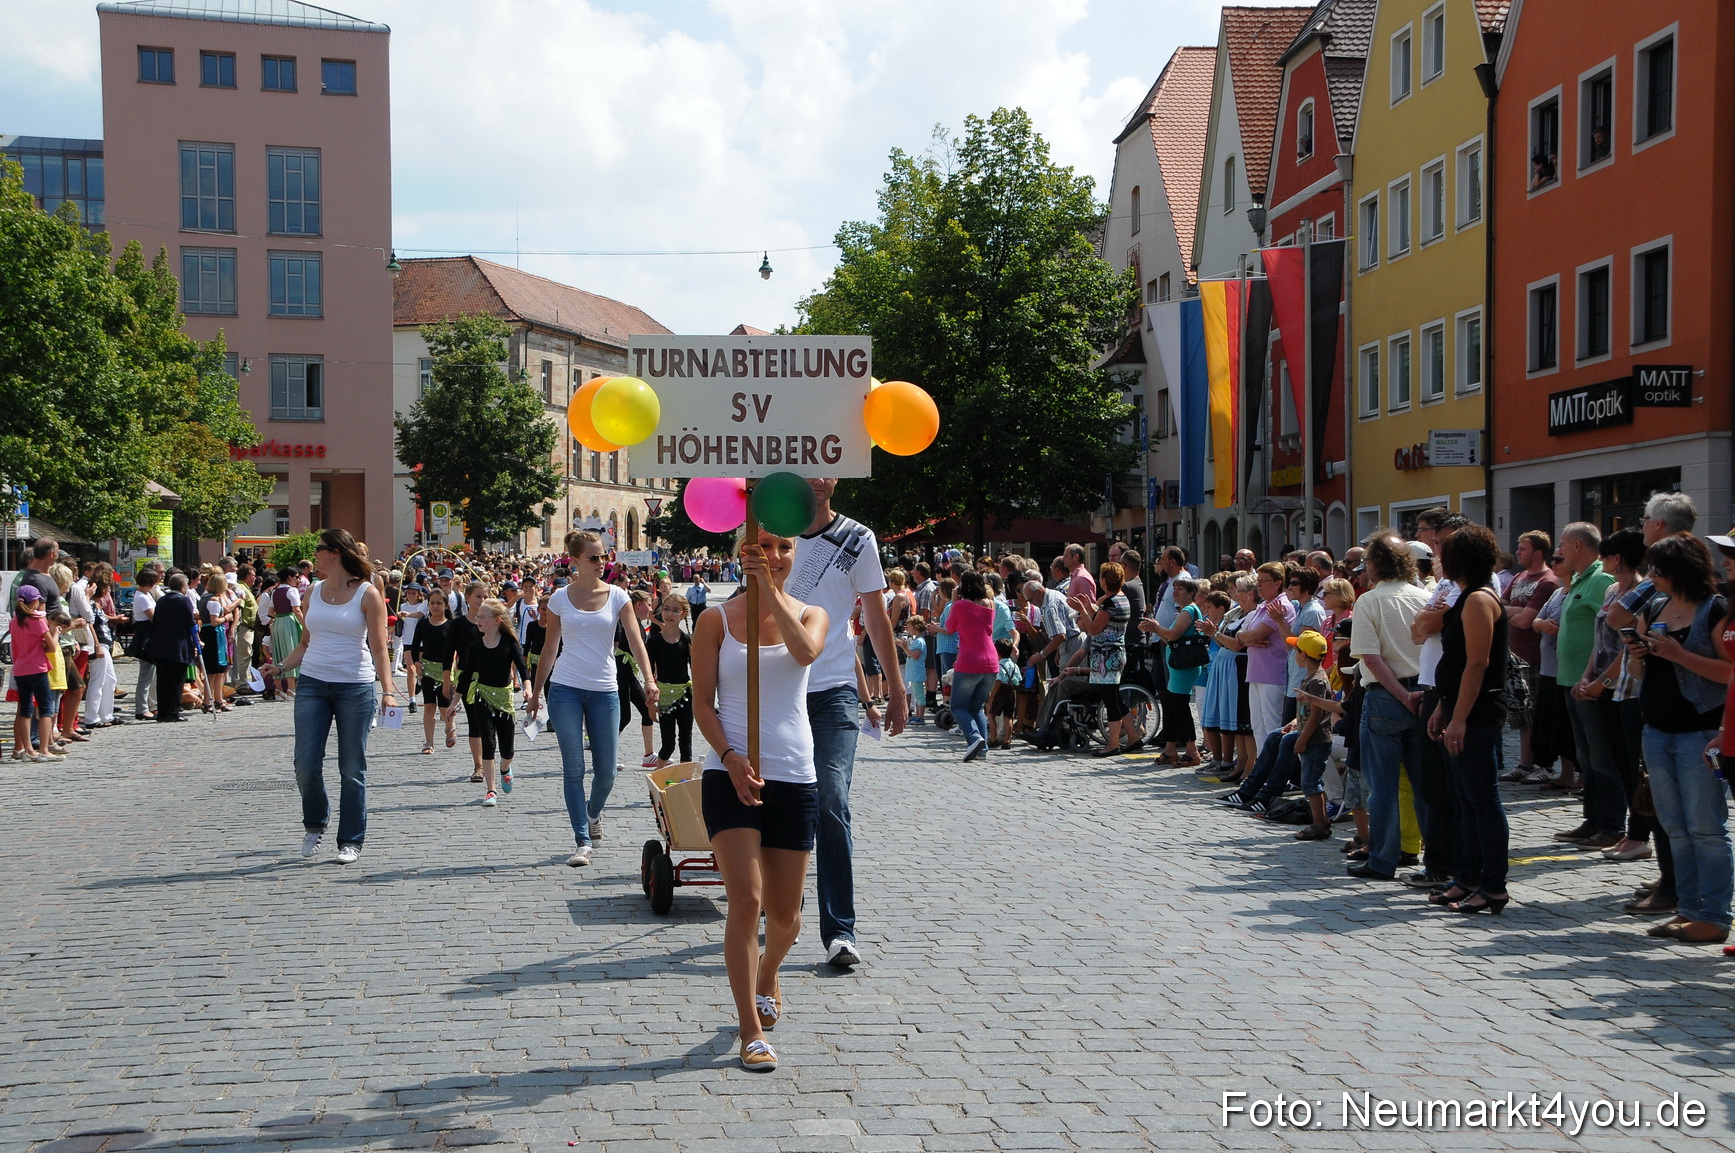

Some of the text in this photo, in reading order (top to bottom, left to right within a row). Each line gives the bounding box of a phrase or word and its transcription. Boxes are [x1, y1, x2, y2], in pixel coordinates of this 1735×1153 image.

[633, 348, 868, 378] TURNABTEILUNG
[1639, 370, 1689, 388] MATT
[1644, 390, 1681, 404] optik
[657, 427, 843, 465] HÖHENBERG
[795, 554, 816, 585] RAPID
[809, 536, 828, 558] AND
